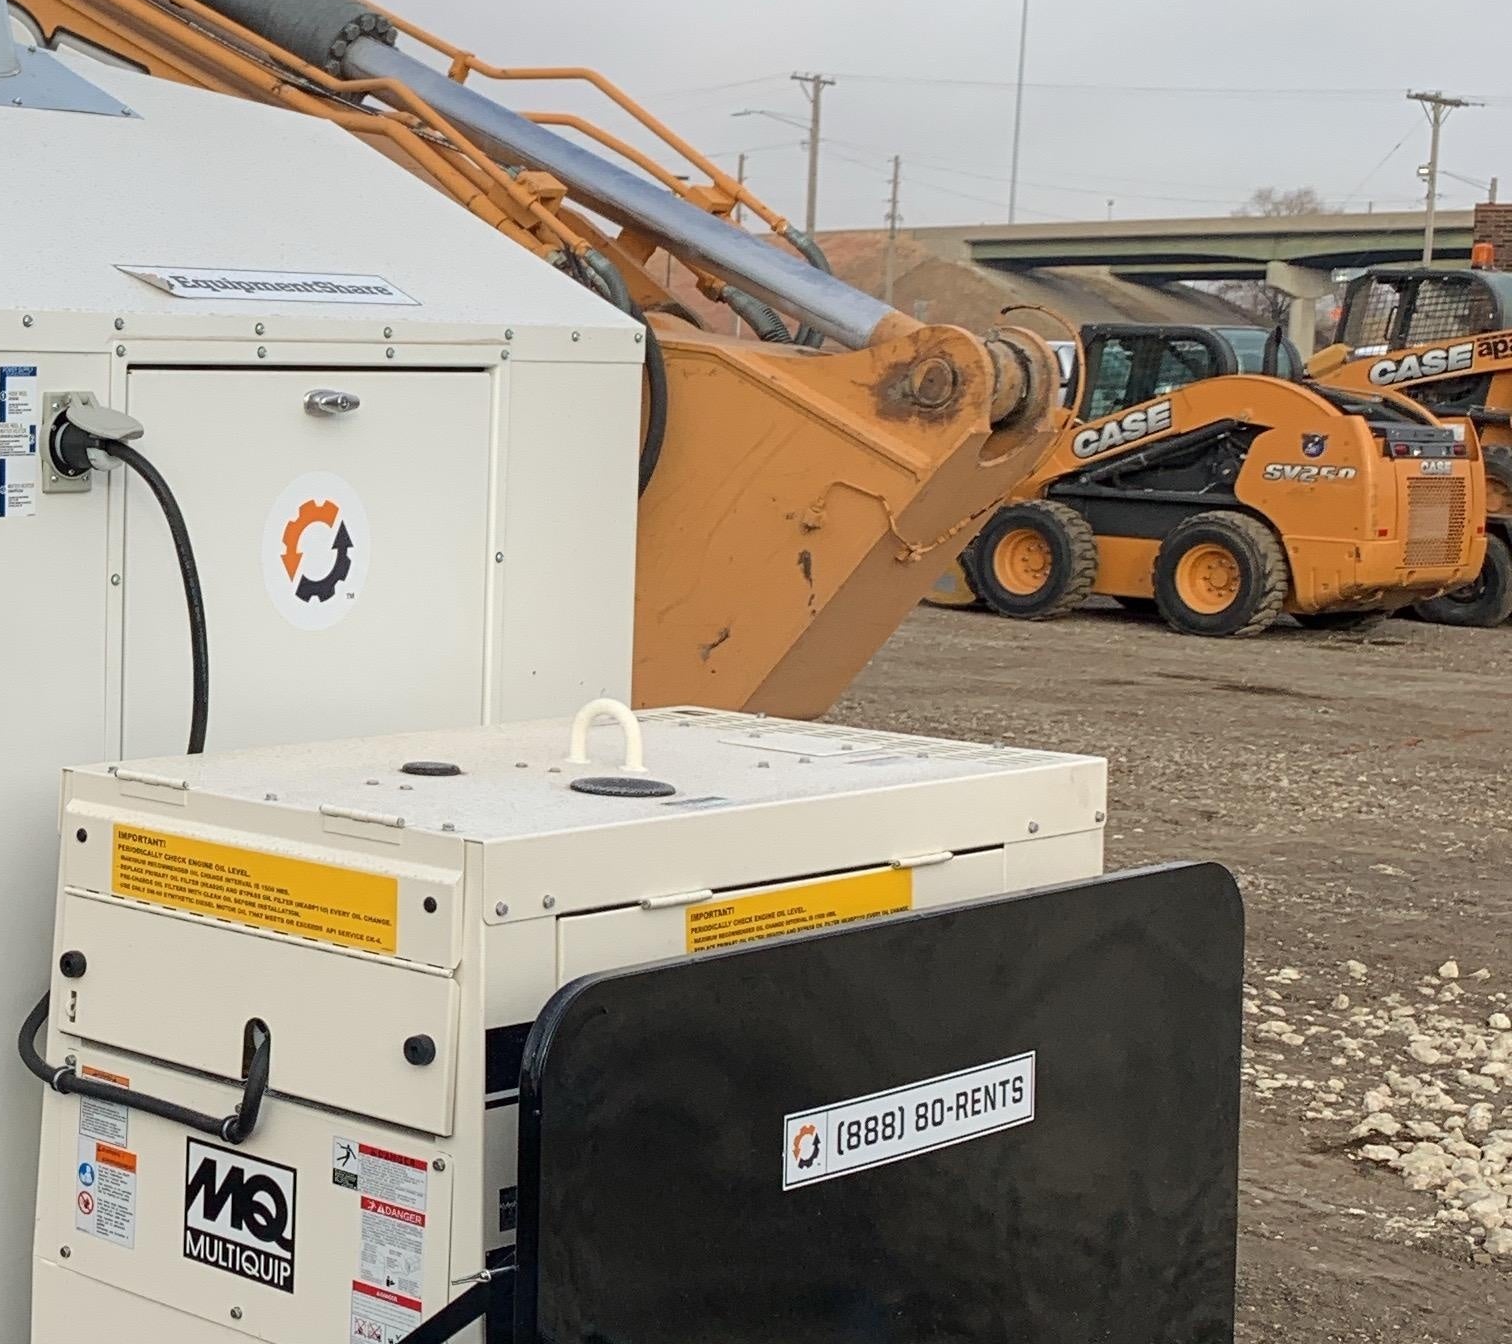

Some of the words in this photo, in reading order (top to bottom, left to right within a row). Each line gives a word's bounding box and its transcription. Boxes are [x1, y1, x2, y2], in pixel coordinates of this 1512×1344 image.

[169, 275, 394, 296] EquipmentShare
[1367, 342, 1474, 385] CASE
[1072, 399, 1172, 459] CASE
[1420, 460, 1453, 475] CASE
[118, 830, 166, 848] IMPORTANT!
[117, 843, 162, 859] PERIODICALLY
[164, 853, 186, 864] CHECK
[188, 858, 213, 869] ENGINE
[214, 863, 225, 872] OIL
[228, 866, 250, 877] LEVEL.
[690, 905, 734, 922] IMPORTANT!
[837, 1106, 904, 1155] (888)
[915, 1075, 1024, 1132] 80-RENTS
[188, 1157, 292, 1253] MQ
[385, 1206, 422, 1224] DANGER
[186, 1230, 291, 1286] MULTIQUIP
